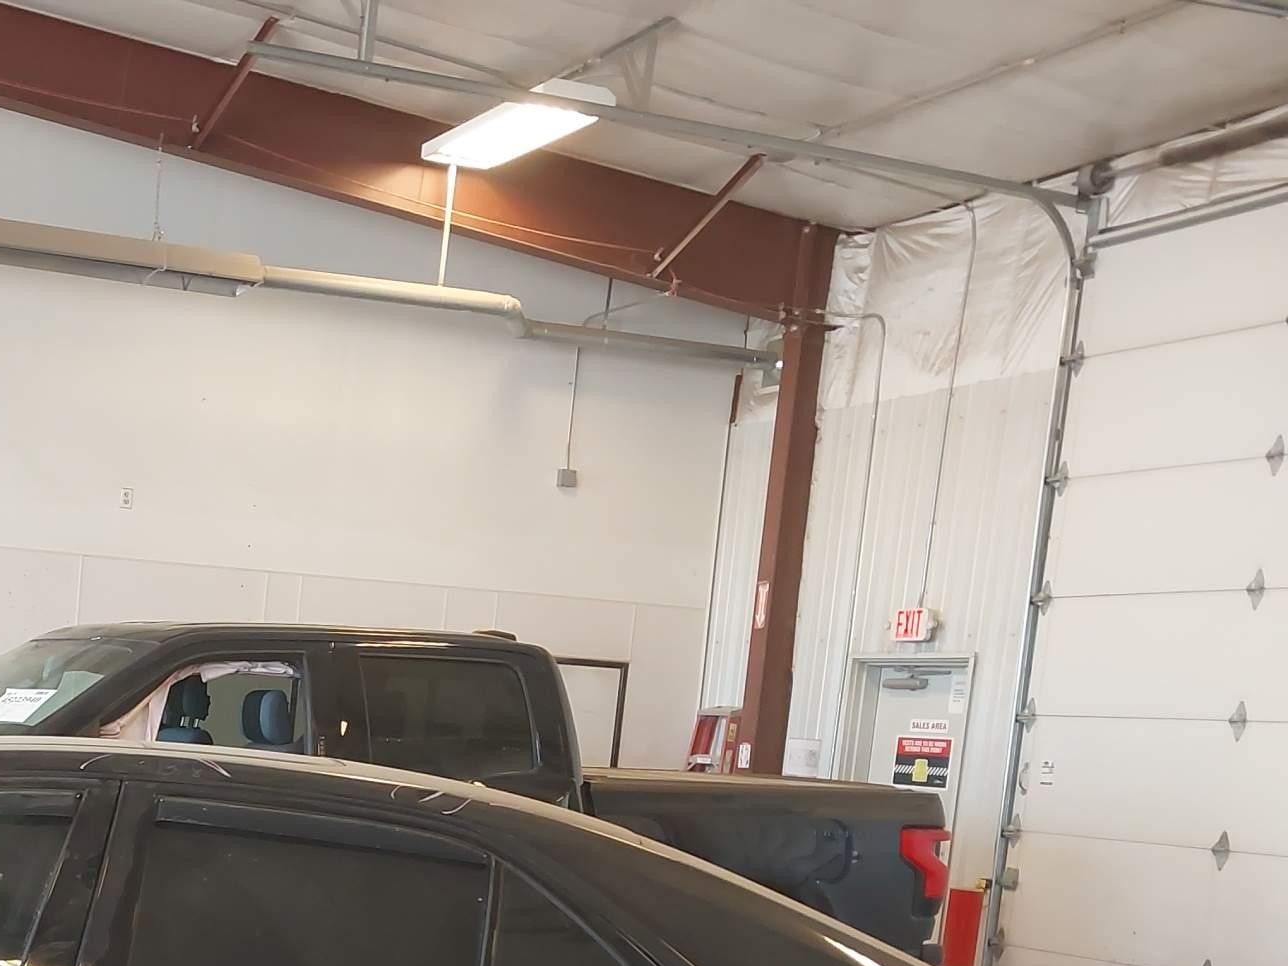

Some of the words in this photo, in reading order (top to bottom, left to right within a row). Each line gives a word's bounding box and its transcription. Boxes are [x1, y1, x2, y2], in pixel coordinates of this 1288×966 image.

[895, 610, 923, 638] EXIT
[911, 721, 930, 730] SALES
[931, 722, 947, 730] AREA
